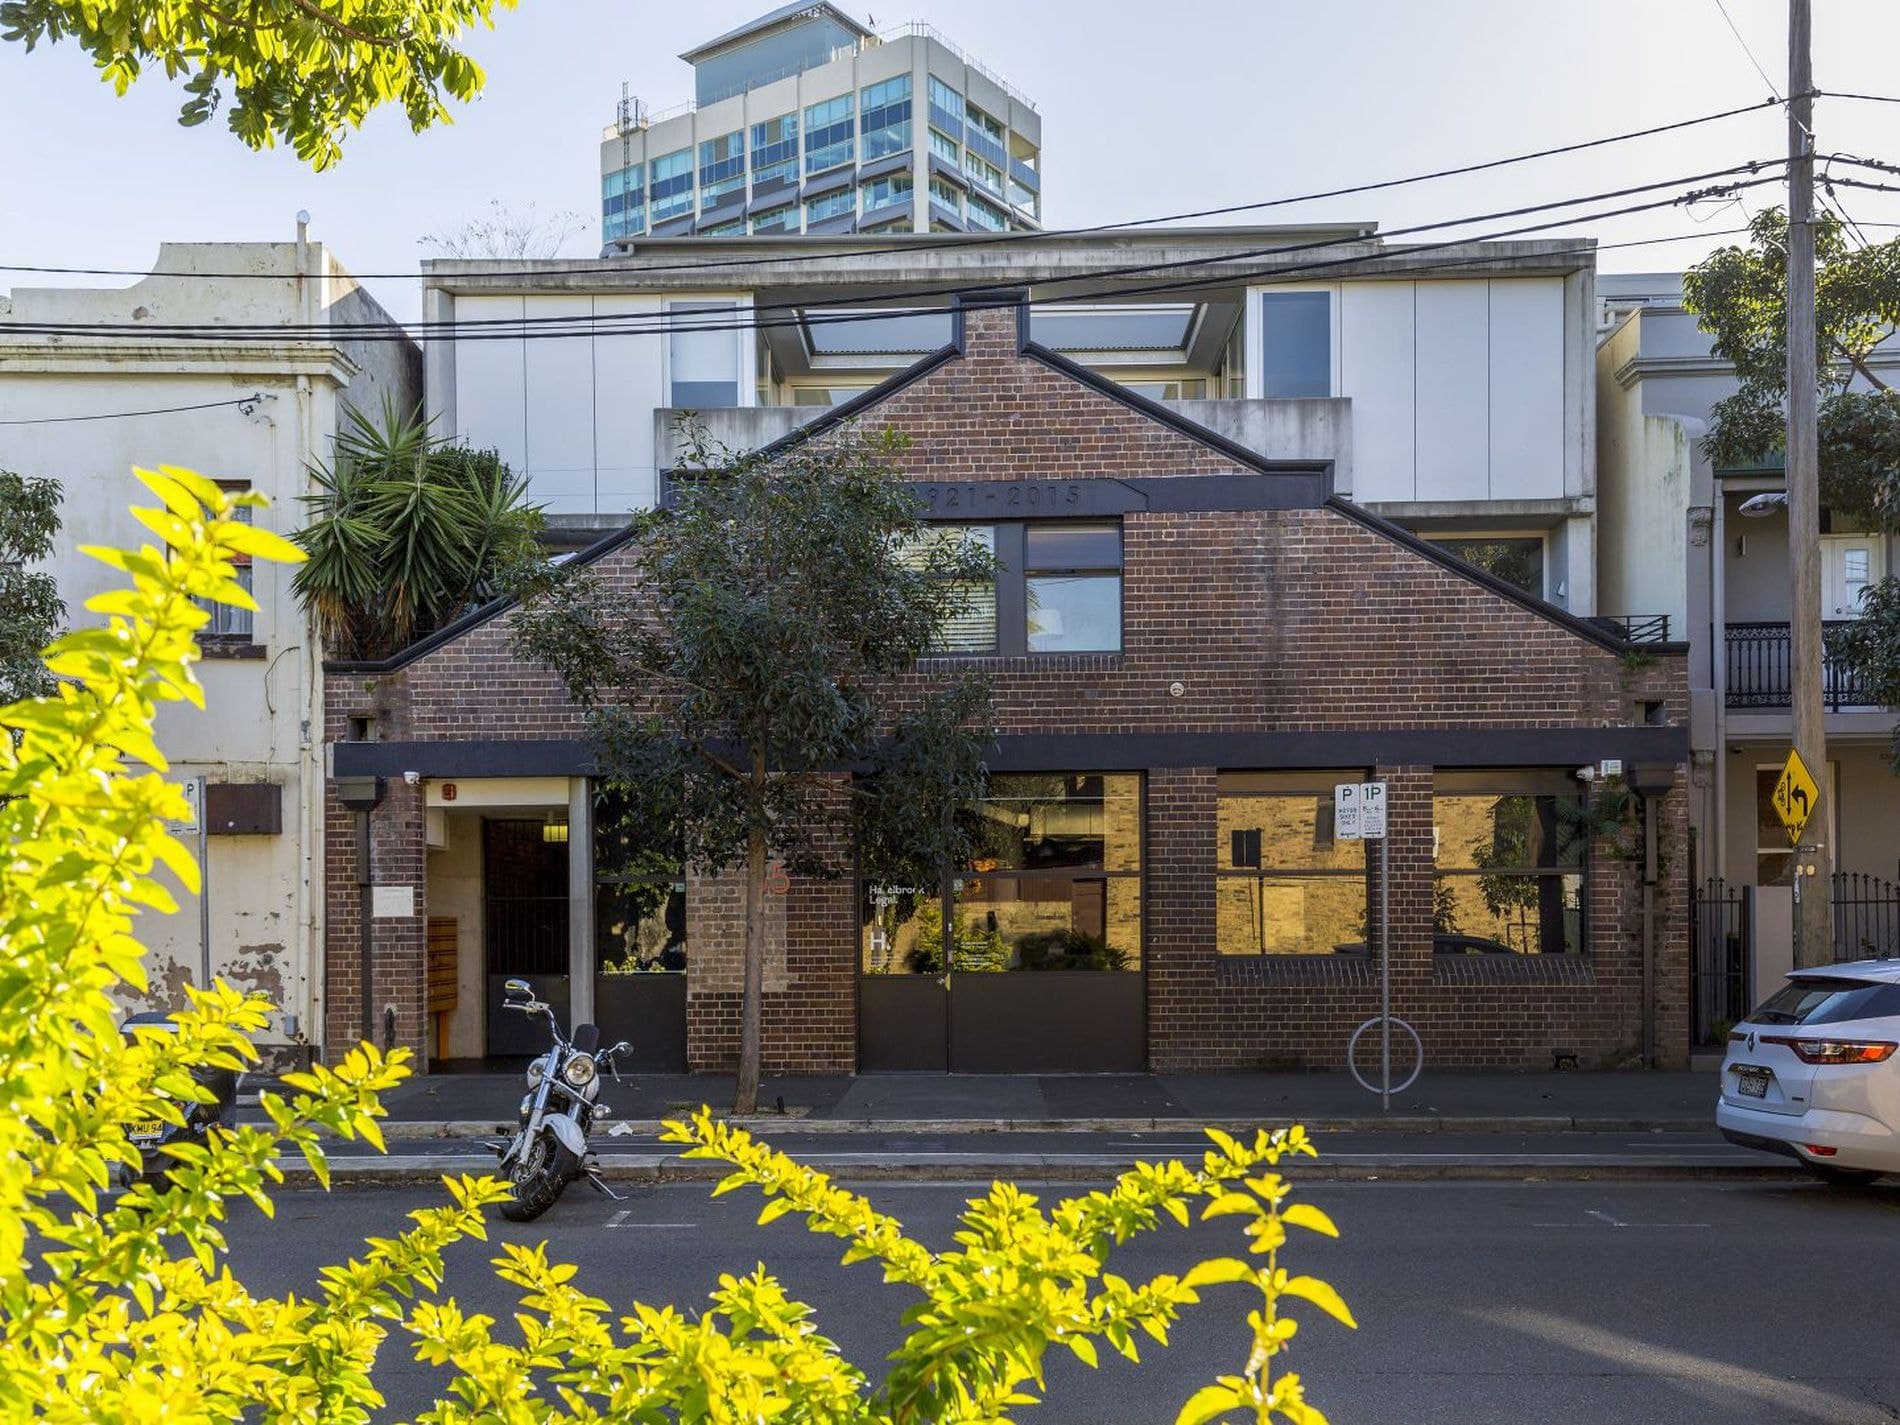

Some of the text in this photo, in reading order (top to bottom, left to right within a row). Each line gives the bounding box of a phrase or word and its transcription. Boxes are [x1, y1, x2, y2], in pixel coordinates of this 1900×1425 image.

[187, 783, 195, 797] P
[1342, 788, 1352, 802] P
[1364, 786, 1382, 801] 1P
